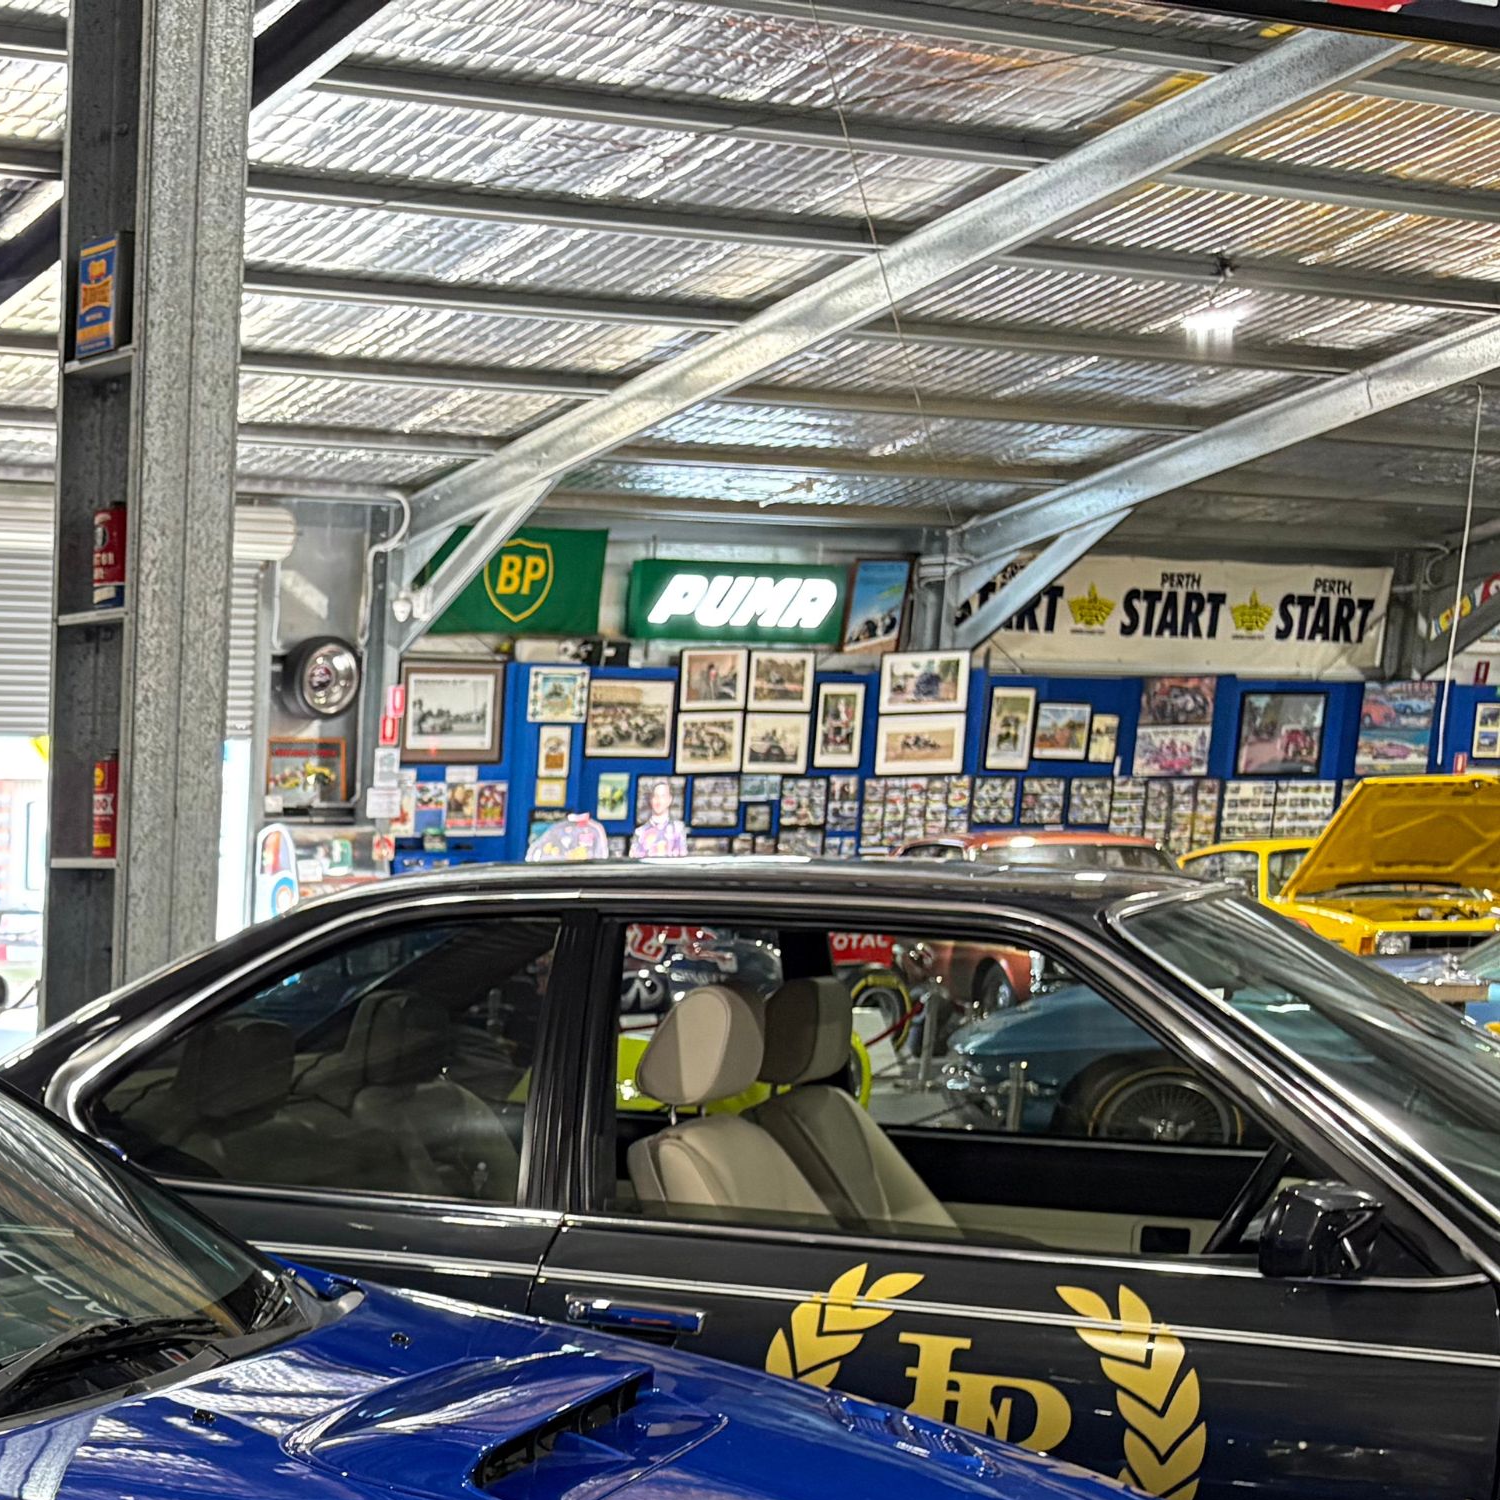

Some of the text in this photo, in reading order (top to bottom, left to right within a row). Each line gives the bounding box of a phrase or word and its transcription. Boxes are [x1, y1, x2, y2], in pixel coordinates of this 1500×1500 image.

[495, 554, 547, 595] BP
[1161, 571, 1201, 589] PERTH
[1313, 576, 1353, 595] PERTH
[647, 574, 838, 629] PUMA
[1120, 587, 1227, 639] START
[1275, 592, 1375, 644] START
[831, 933, 890, 949] OTAL
